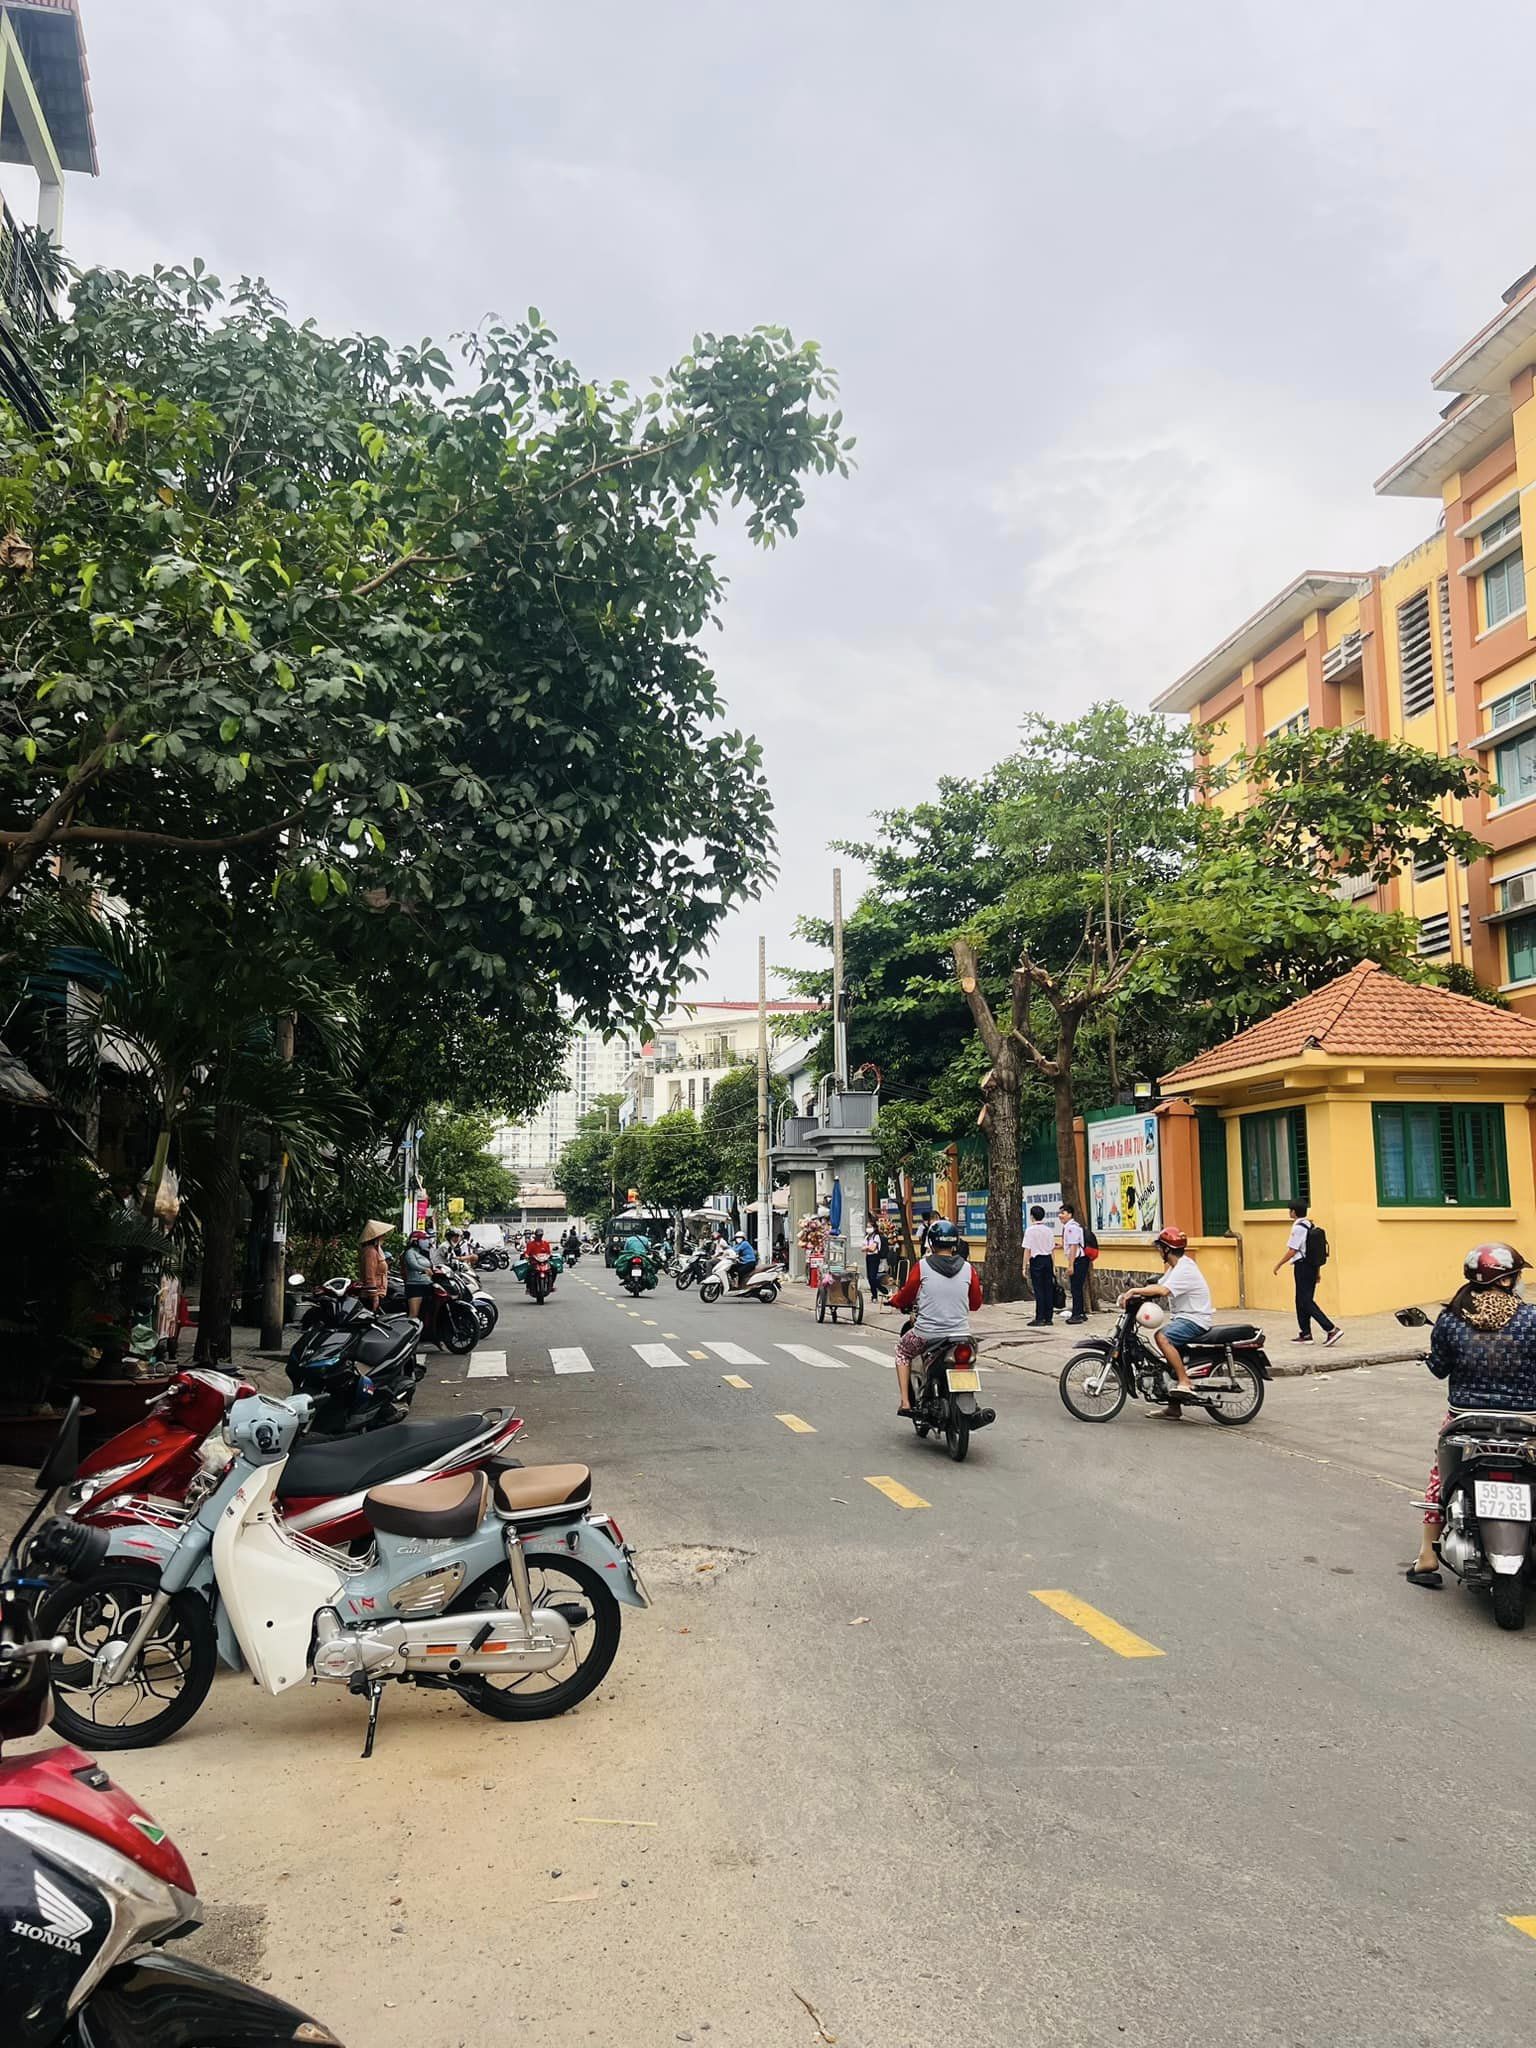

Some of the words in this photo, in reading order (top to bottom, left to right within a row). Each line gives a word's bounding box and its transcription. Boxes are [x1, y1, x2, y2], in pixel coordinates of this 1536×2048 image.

[1482, 1484, 1522, 1501] 59-S3
[1479, 1500, 1527, 1518] 572.65
[11, 1920, 82, 1955] HONDA
